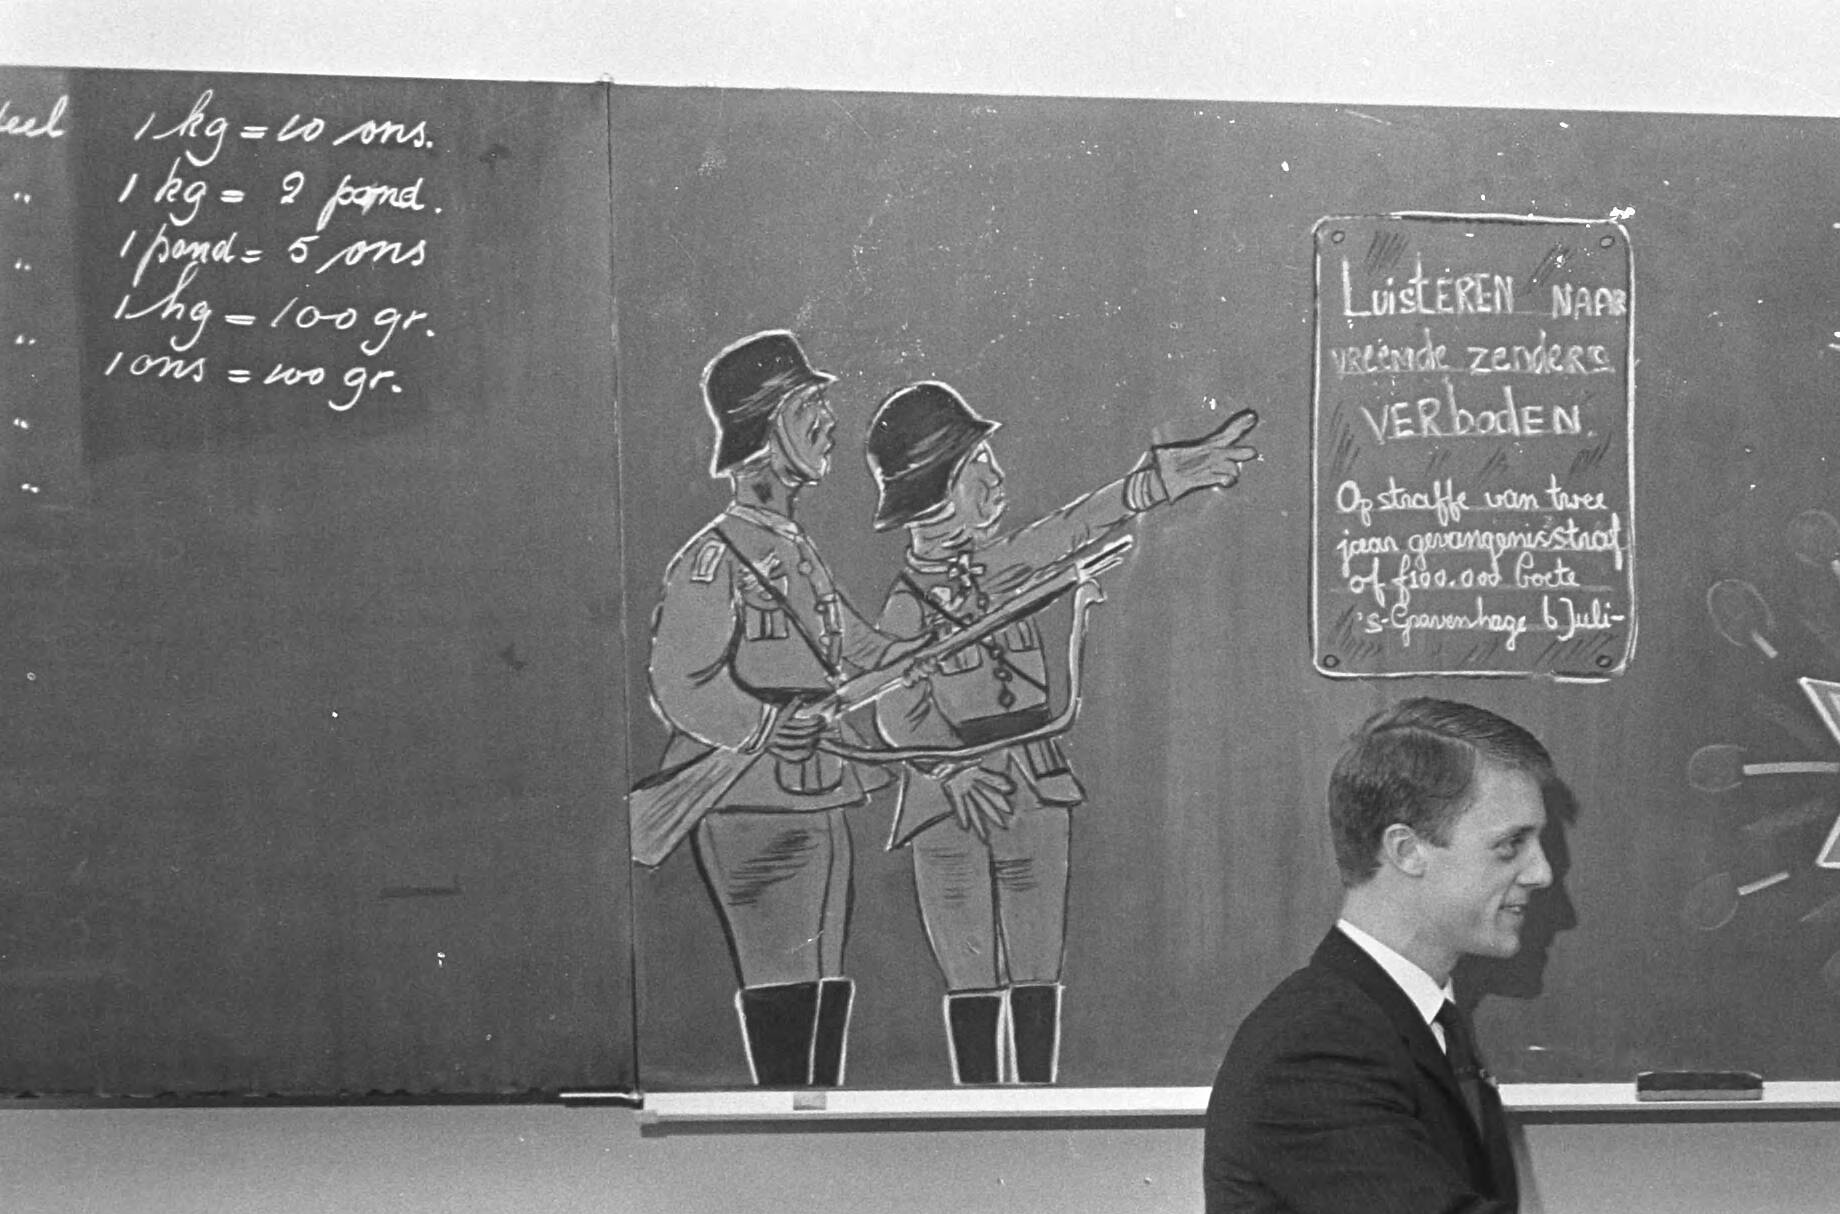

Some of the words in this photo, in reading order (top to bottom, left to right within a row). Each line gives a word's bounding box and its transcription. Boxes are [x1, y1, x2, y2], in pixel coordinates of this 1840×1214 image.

[153, 89, 228, 166] kg
[118, 173, 138, 202] 1
[154, 157, 207, 227] kg
[280, 170, 305, 205] 2
[120, 229, 137, 258] 1
[132, 223, 238, 288] pond
[288, 235, 320, 264] 5
[315, 237, 426, 274] ons
[270, 296, 357, 329] 100
[130, 353, 206, 383] ons
[263, 362, 326, 387] 100
[1336, 480, 1373, 527] Op
[1377, 475, 1470, 527] straffe
[1484, 488, 1540, 511] van
[1545, 473, 1609, 511] twee
[1350, 556, 1385, 608] of
